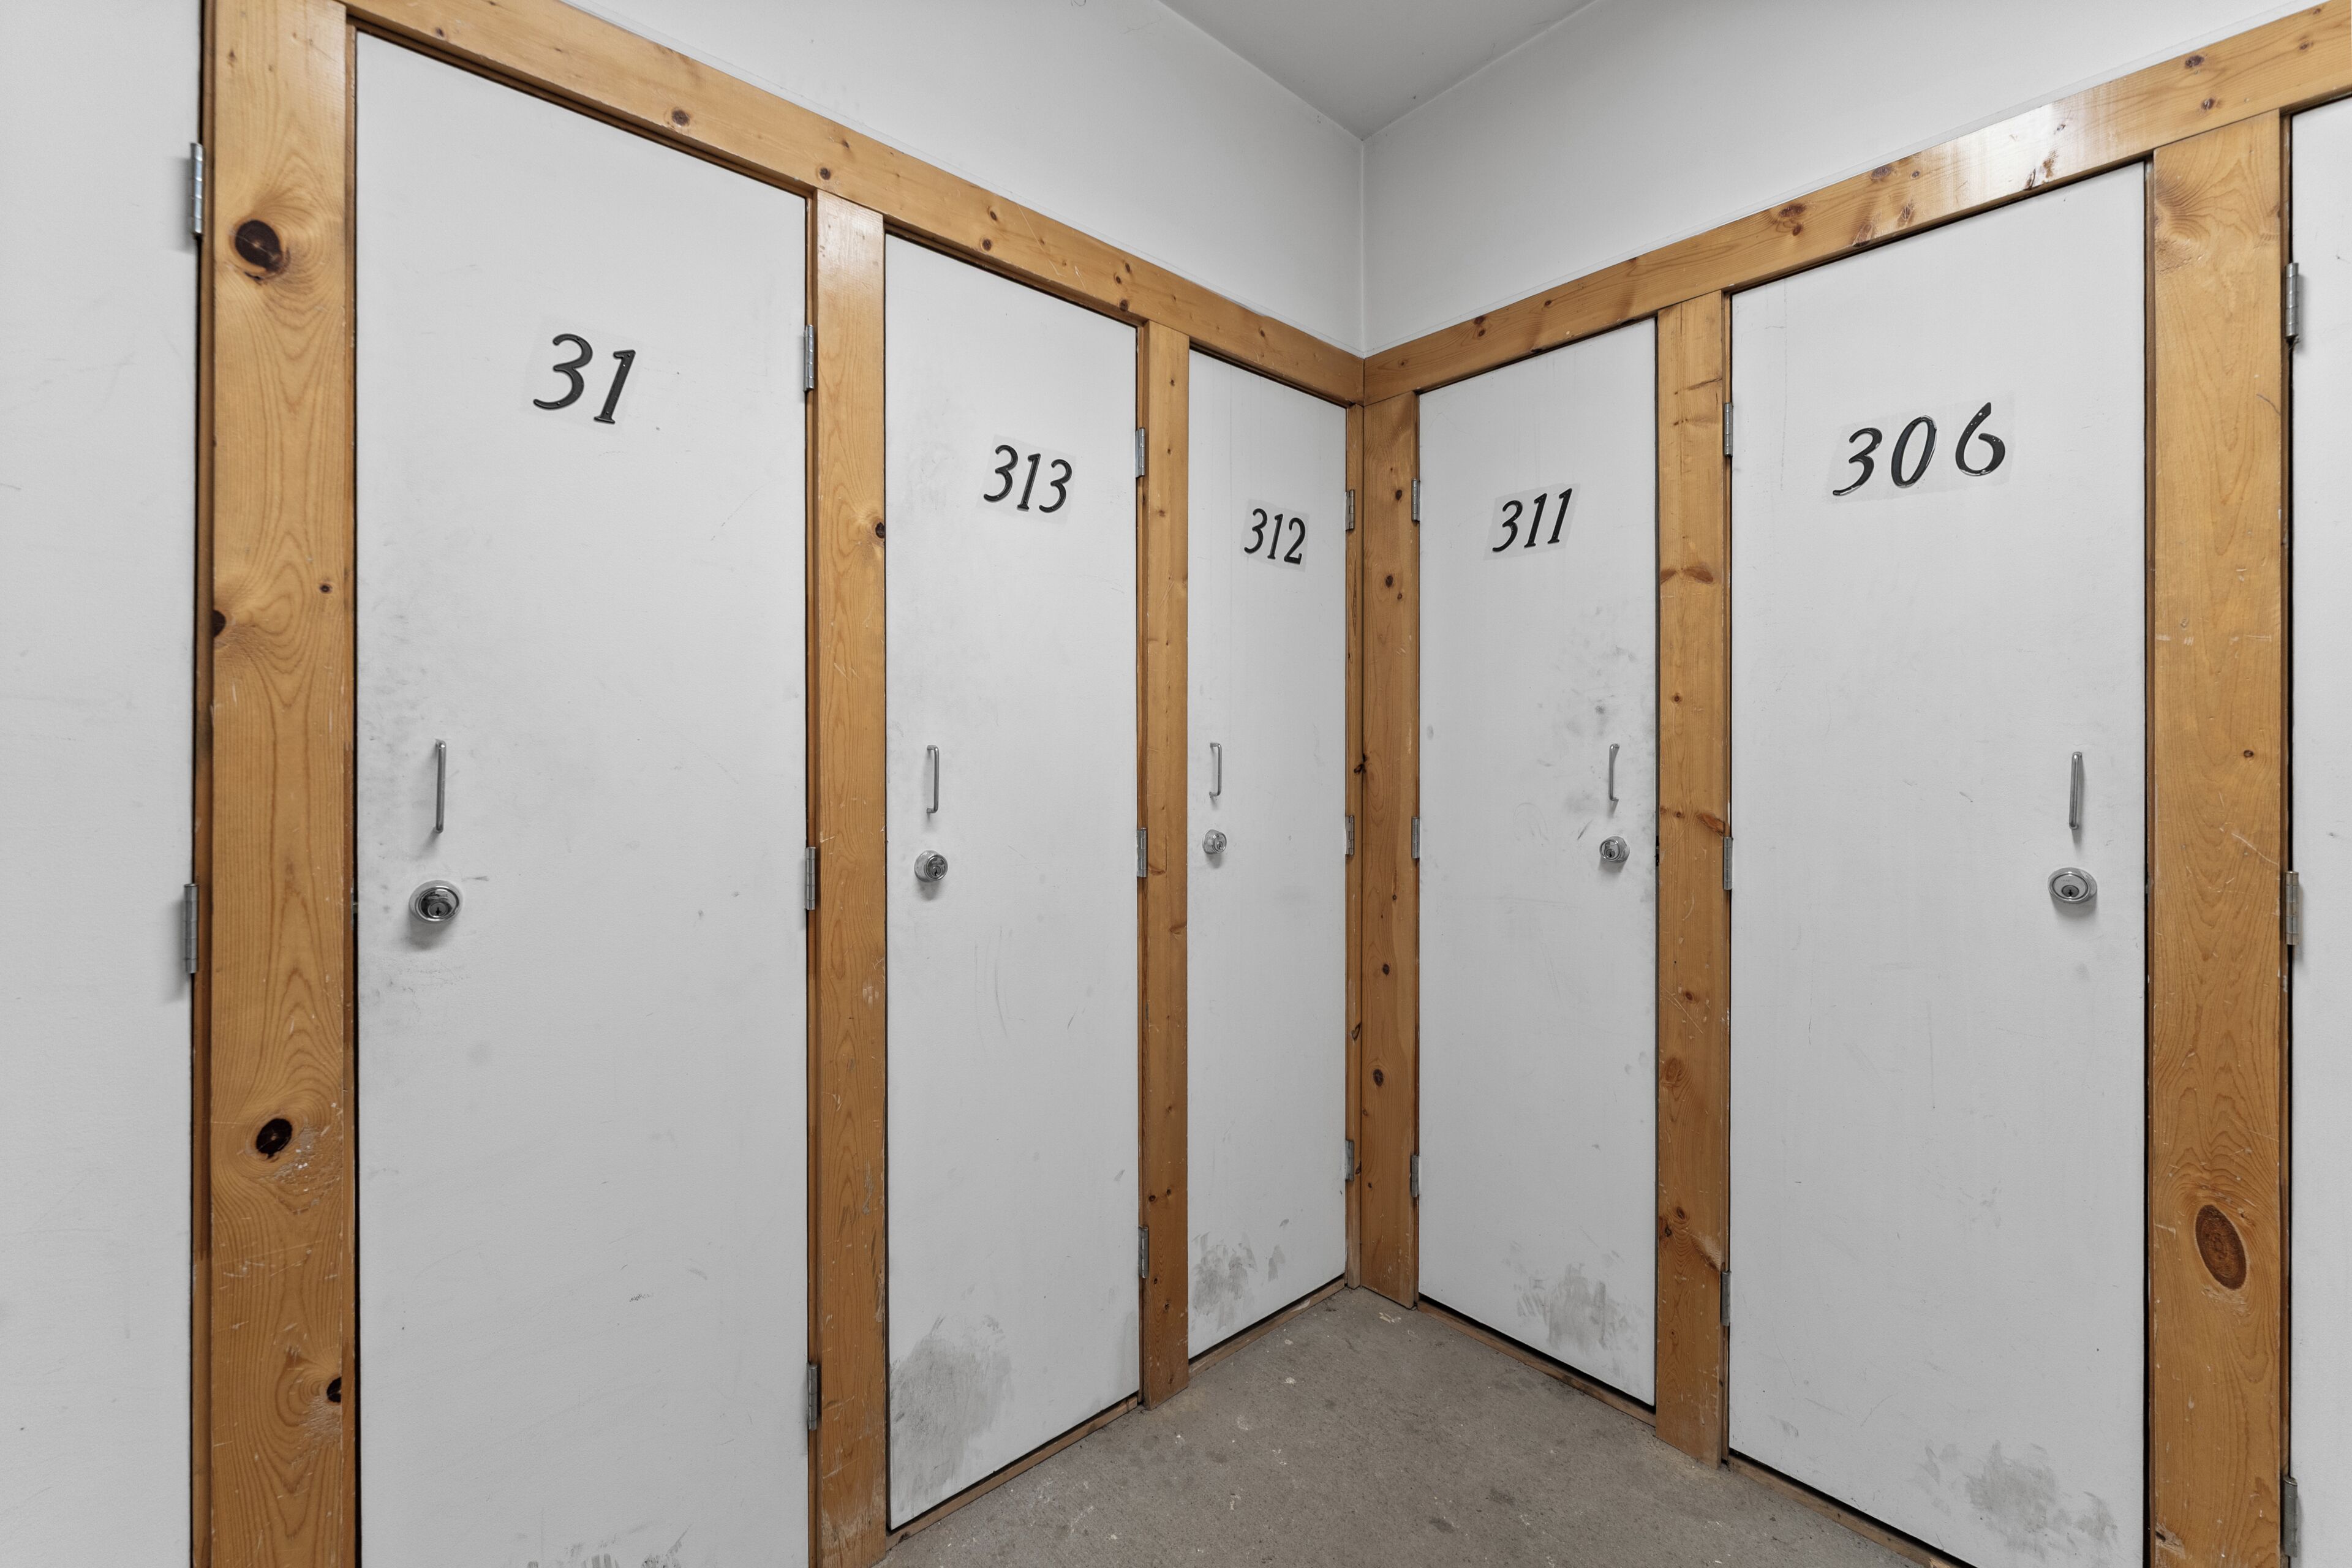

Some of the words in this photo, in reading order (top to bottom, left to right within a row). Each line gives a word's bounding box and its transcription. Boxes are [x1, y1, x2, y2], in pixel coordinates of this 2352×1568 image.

[532, 333, 636, 425] 31
[982, 444, 1073, 514] 313
[1831, 401, 2007, 497] 306
[1243, 507, 1306, 565] 312
[1491, 487, 1574, 553] 311
